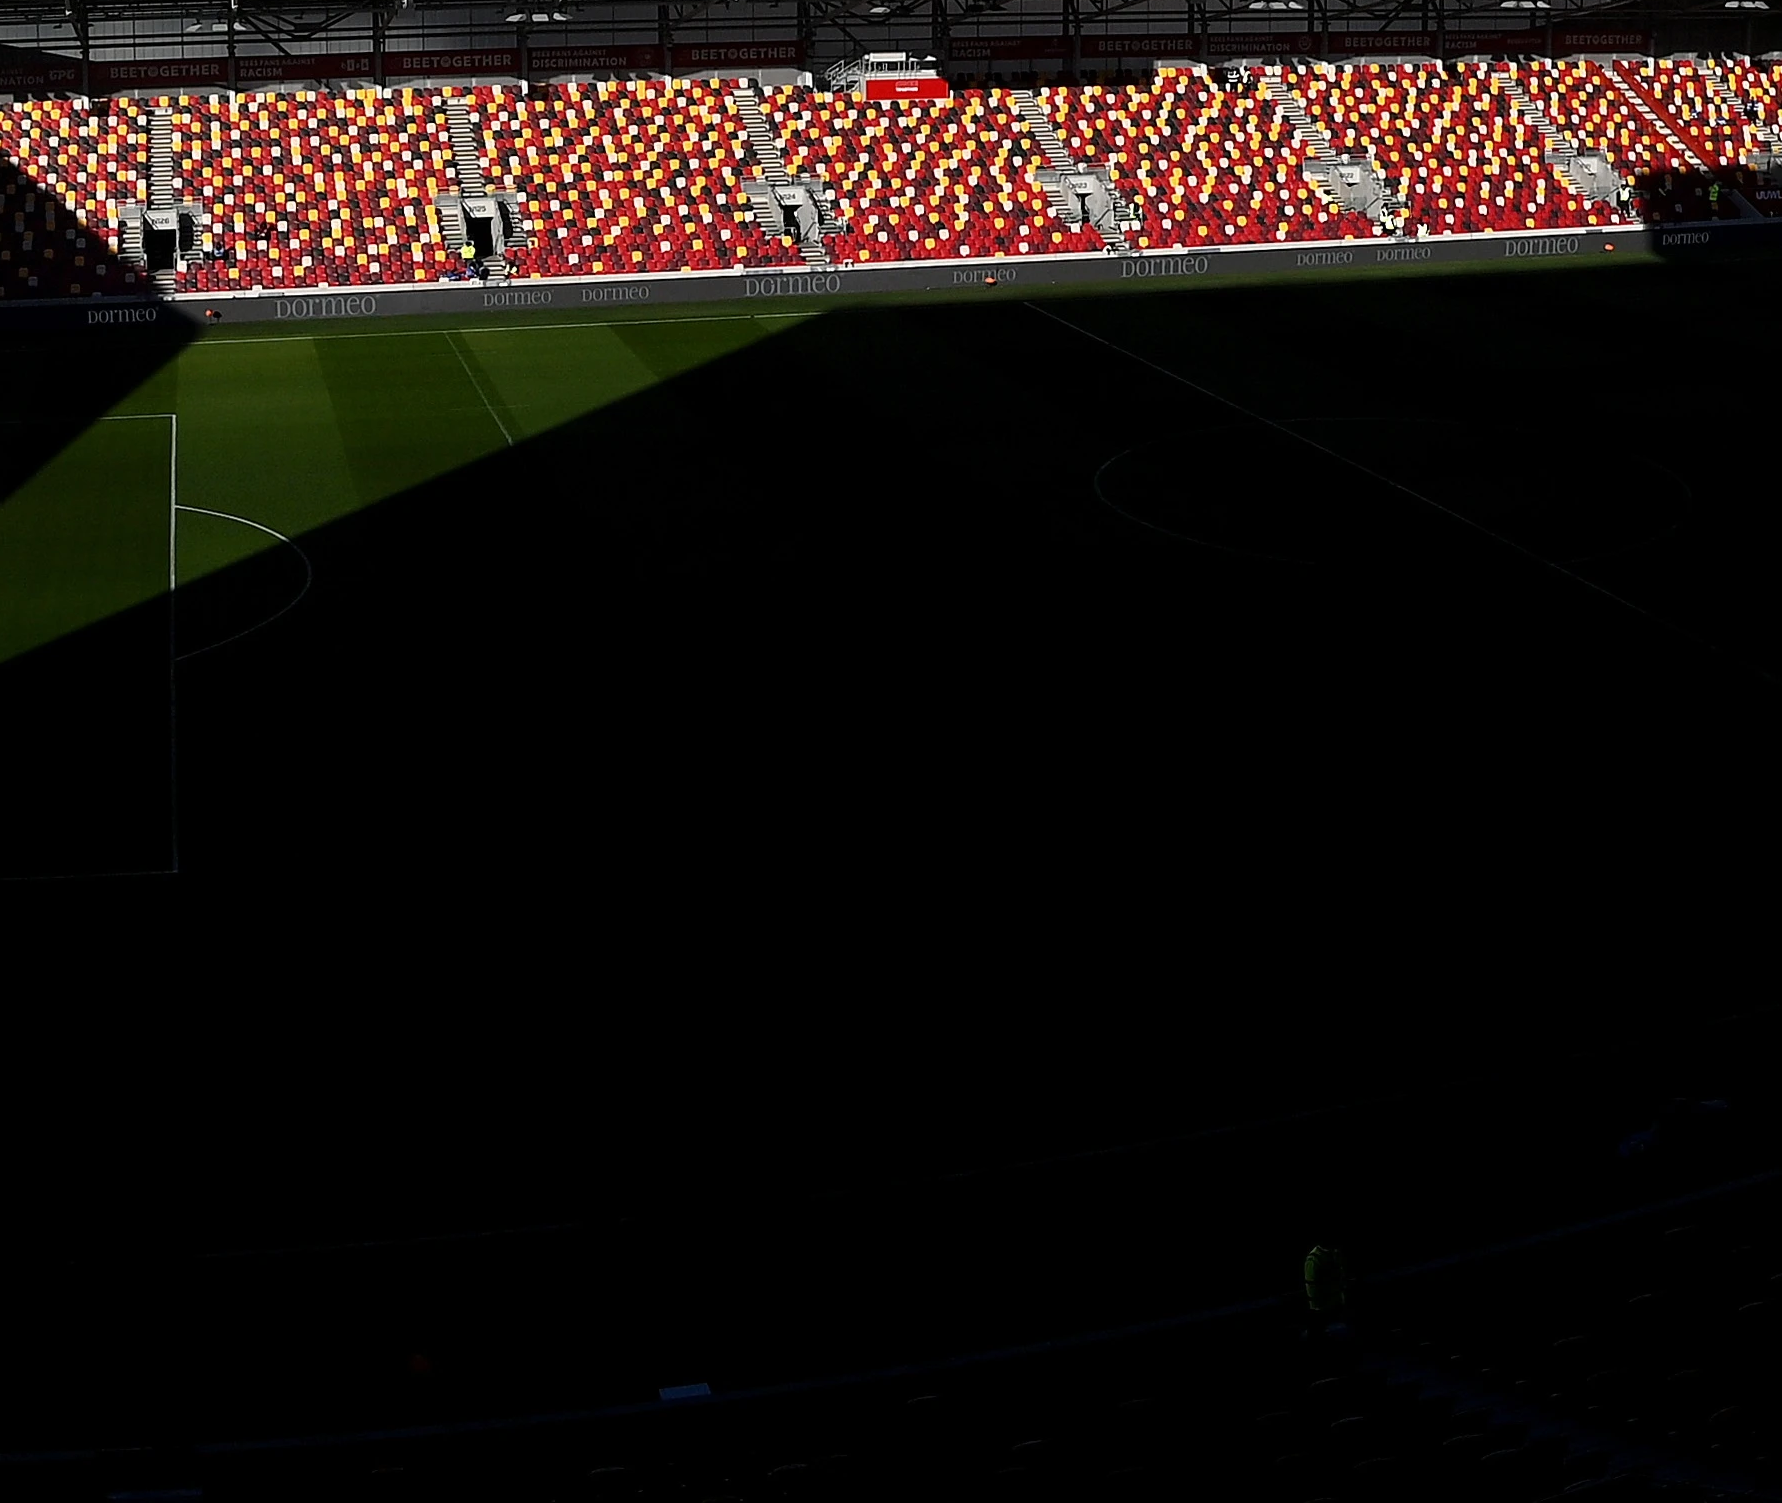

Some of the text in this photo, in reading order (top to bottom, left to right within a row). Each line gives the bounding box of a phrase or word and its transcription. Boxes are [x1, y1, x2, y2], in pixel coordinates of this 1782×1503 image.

[1098, 39, 1193, 52] BEETOGETHER
[1210, 42, 1290, 52] DISCRIMINATION
[1345, 36, 1431, 47] BEETOGETHER
[691, 47, 796, 61] BEETOGETHER
[951, 48, 991, 58] RACISM
[403, 54, 512, 69] BEETOGETHER
[532, 57, 627, 68] DISCRIMINATION
[109, 63, 220, 79] BEETOGETHER
[240, 67, 283, 78] RACISM
[1504, 236, 1579, 257] Dormeo
[1120, 255, 1209, 278] Dormeo
[744, 273, 841, 297] Dormeo
[274, 295, 377, 319] Dormeo
[87, 307, 157, 324] Dormeo
